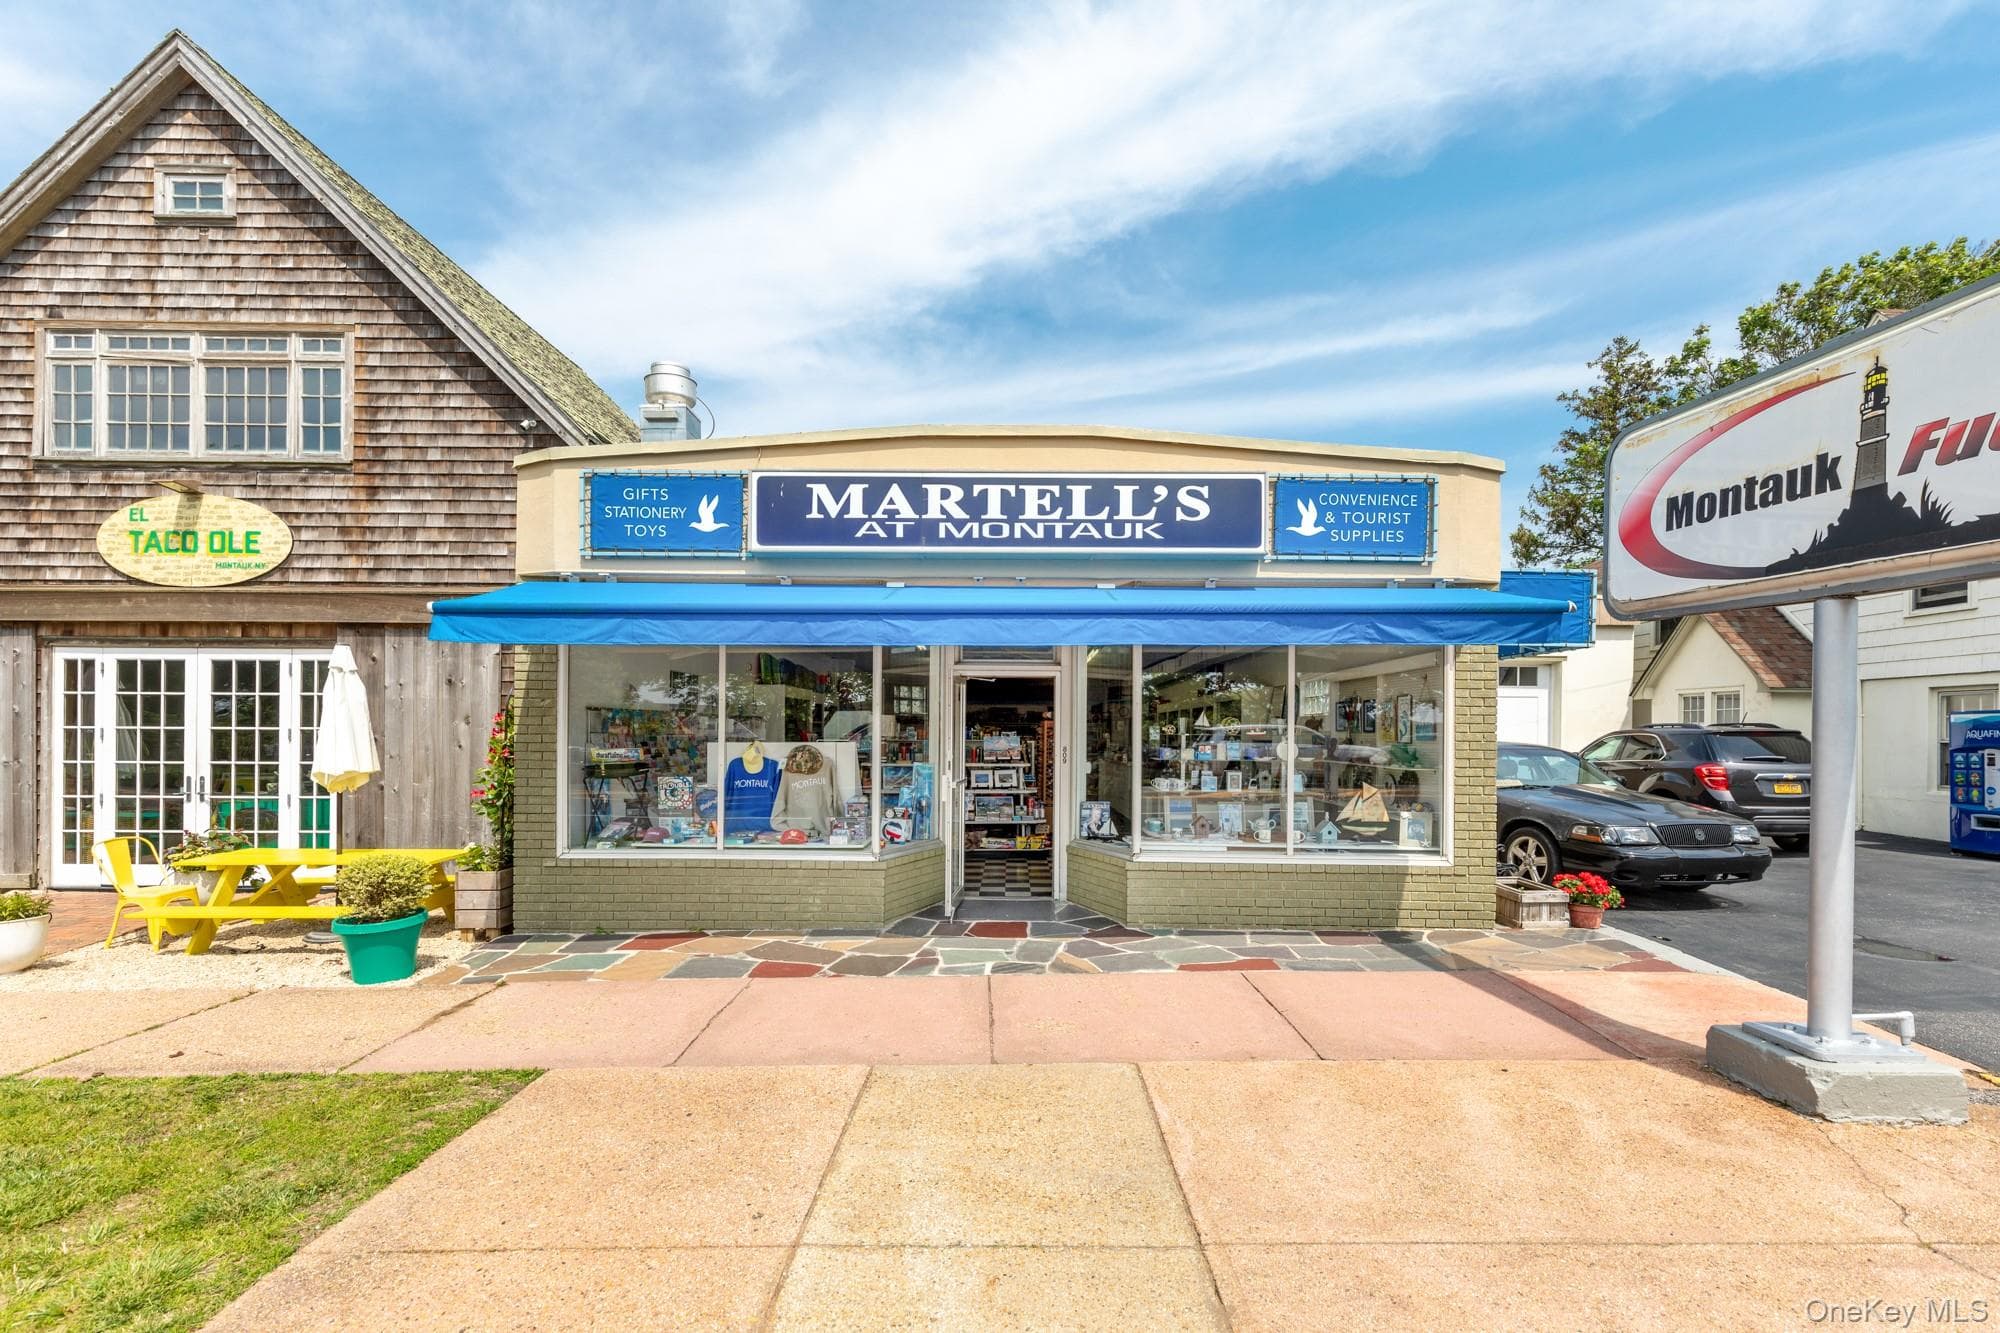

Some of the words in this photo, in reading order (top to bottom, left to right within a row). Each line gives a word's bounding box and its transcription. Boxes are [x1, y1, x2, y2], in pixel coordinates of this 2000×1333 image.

[1897, 411, 2000, 477] Fu
[623, 488, 669, 501] GIFTS
[1665, 452, 1842, 532] Montauk
[806, 483, 1211, 522] MARTELL'S
[1319, 493, 1418, 507] CONVENIENCE
[129, 507, 149, 522] EL
[604, 505, 687, 519] STATIONERY
[1324, 511, 1336, 524] &
[1342, 511, 1411, 525] TOURIST
[624, 524, 667, 537] TOYS
[854, 522, 916, 538] AT
[939, 522, 1165, 539] MONTAUK
[1330, 529, 1405, 543] SUPPLIES
[128, 530, 199, 554] TACO
[208, 530, 262, 554] OLE
